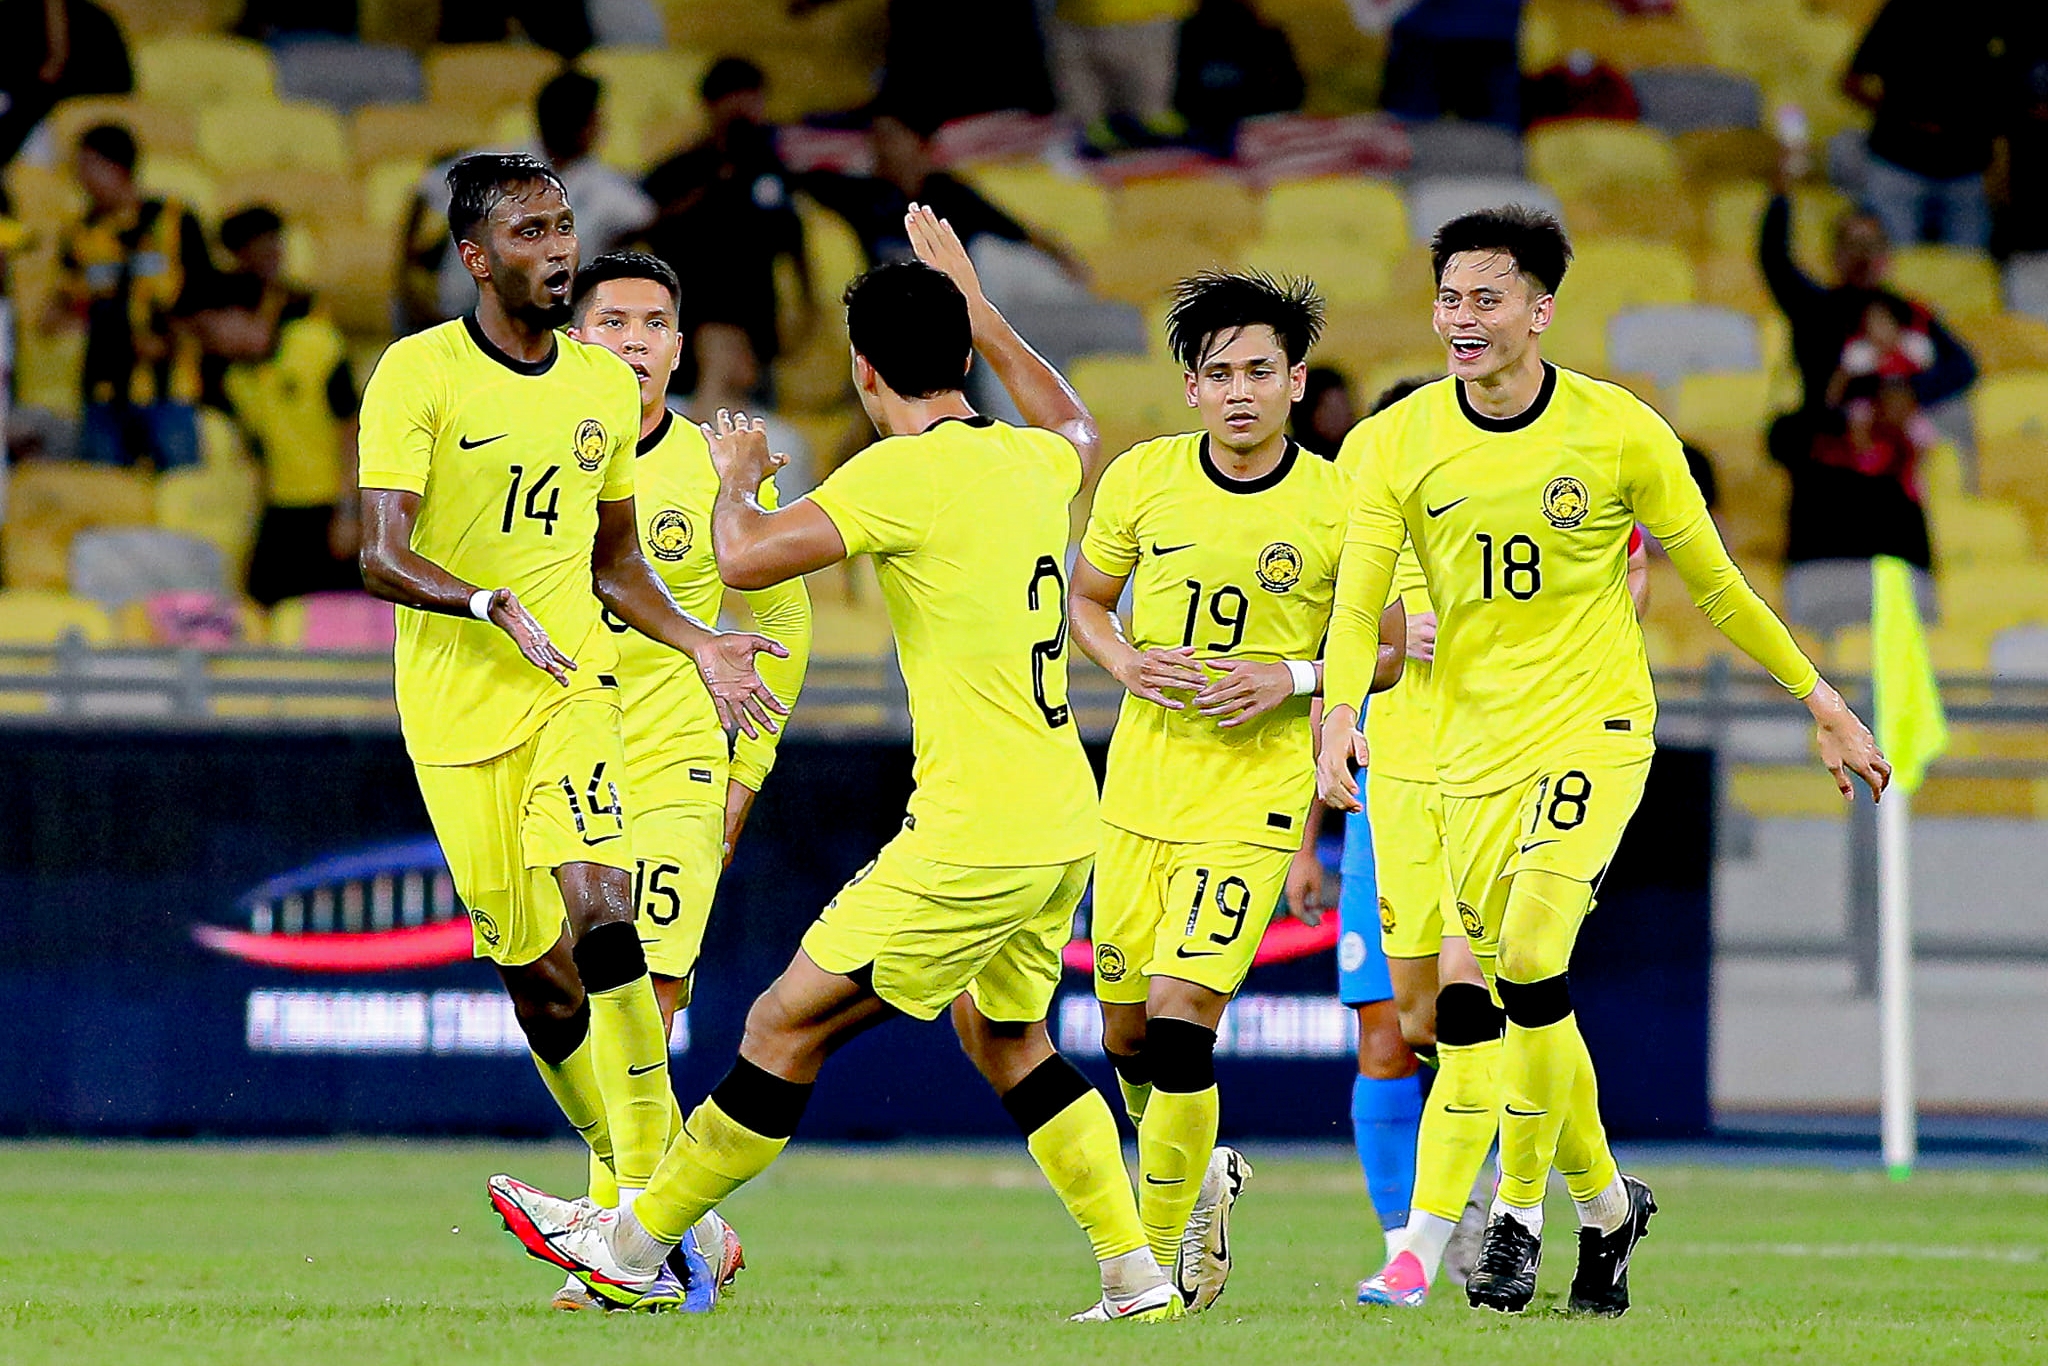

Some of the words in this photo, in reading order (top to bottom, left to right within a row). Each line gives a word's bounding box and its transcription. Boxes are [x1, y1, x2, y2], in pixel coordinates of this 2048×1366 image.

[502, 465, 560, 535] 14
[1476, 533, 1541, 600] 18
[1028, 555, 1068, 729] 2
[1183, 580, 1248, 652] 19
[558, 762, 622, 832] 14
[1530, 770, 1592, 834] 18
[634, 861, 681, 925] 15
[1185, 869, 1250, 945] 19
